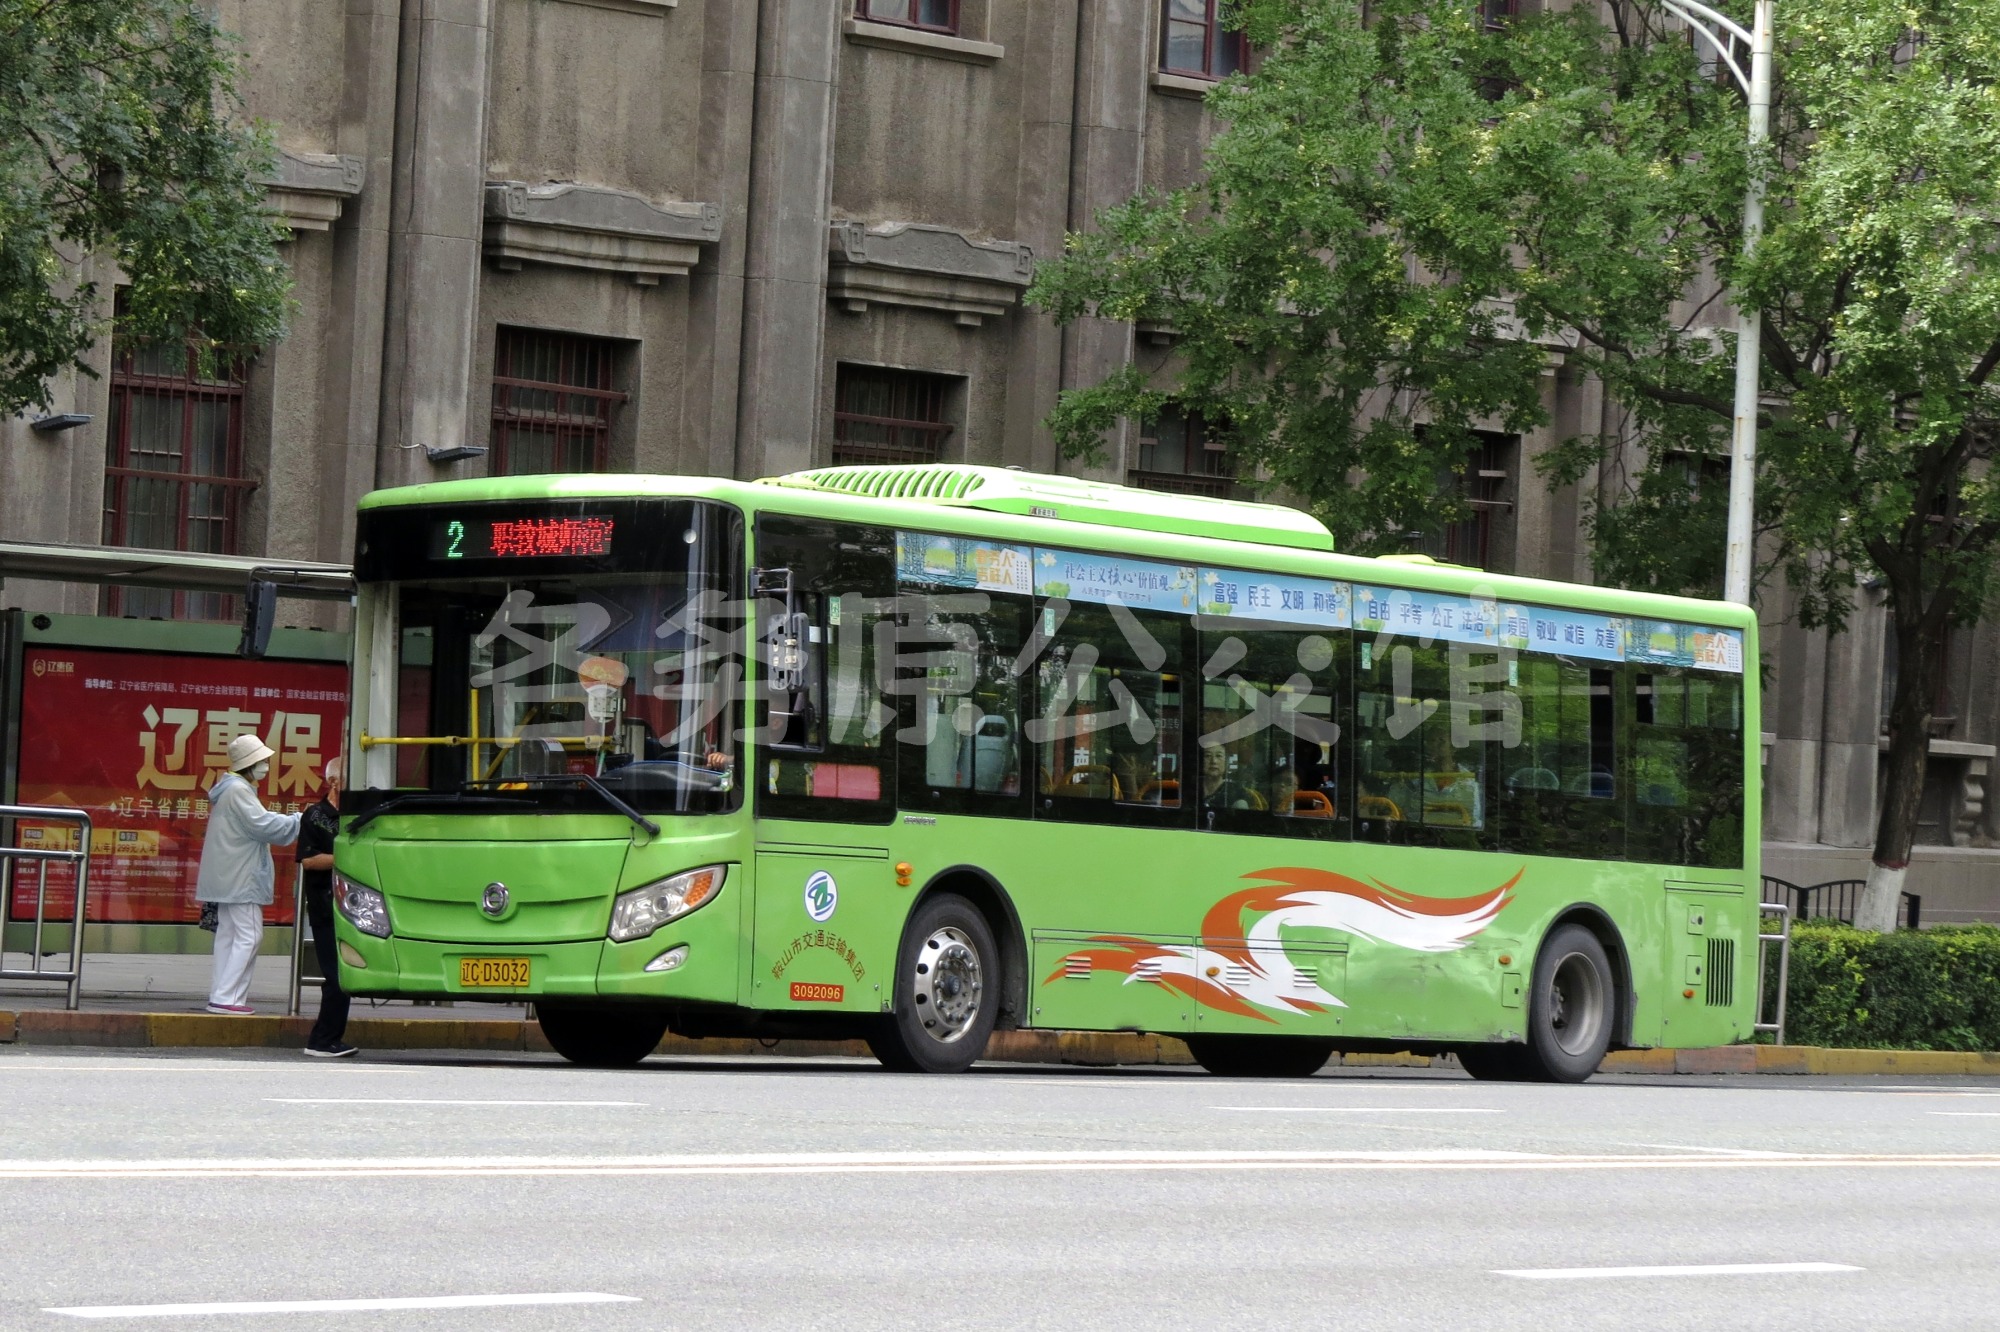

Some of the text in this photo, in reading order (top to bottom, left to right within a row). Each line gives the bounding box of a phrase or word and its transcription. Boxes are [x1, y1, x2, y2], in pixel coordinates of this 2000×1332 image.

[447, 520, 464, 558] 2
[1065, 561, 1169, 591] 社会主义核心价值观
[1214, 581, 1336, 615] 富强 民主 文明 和谐
[1369, 599, 1483, 633] 自由 平等 公正 法治
[1508, 616, 1615, 649] 爱国 敬业 诚信 友善
[47, 661, 74, 673] 辽惠保
[136, 703, 323, 797] 辽惠保
[771, 929, 866, 983] 鞍山市交通运输集团
[793, 984, 841, 1000] 3092096
